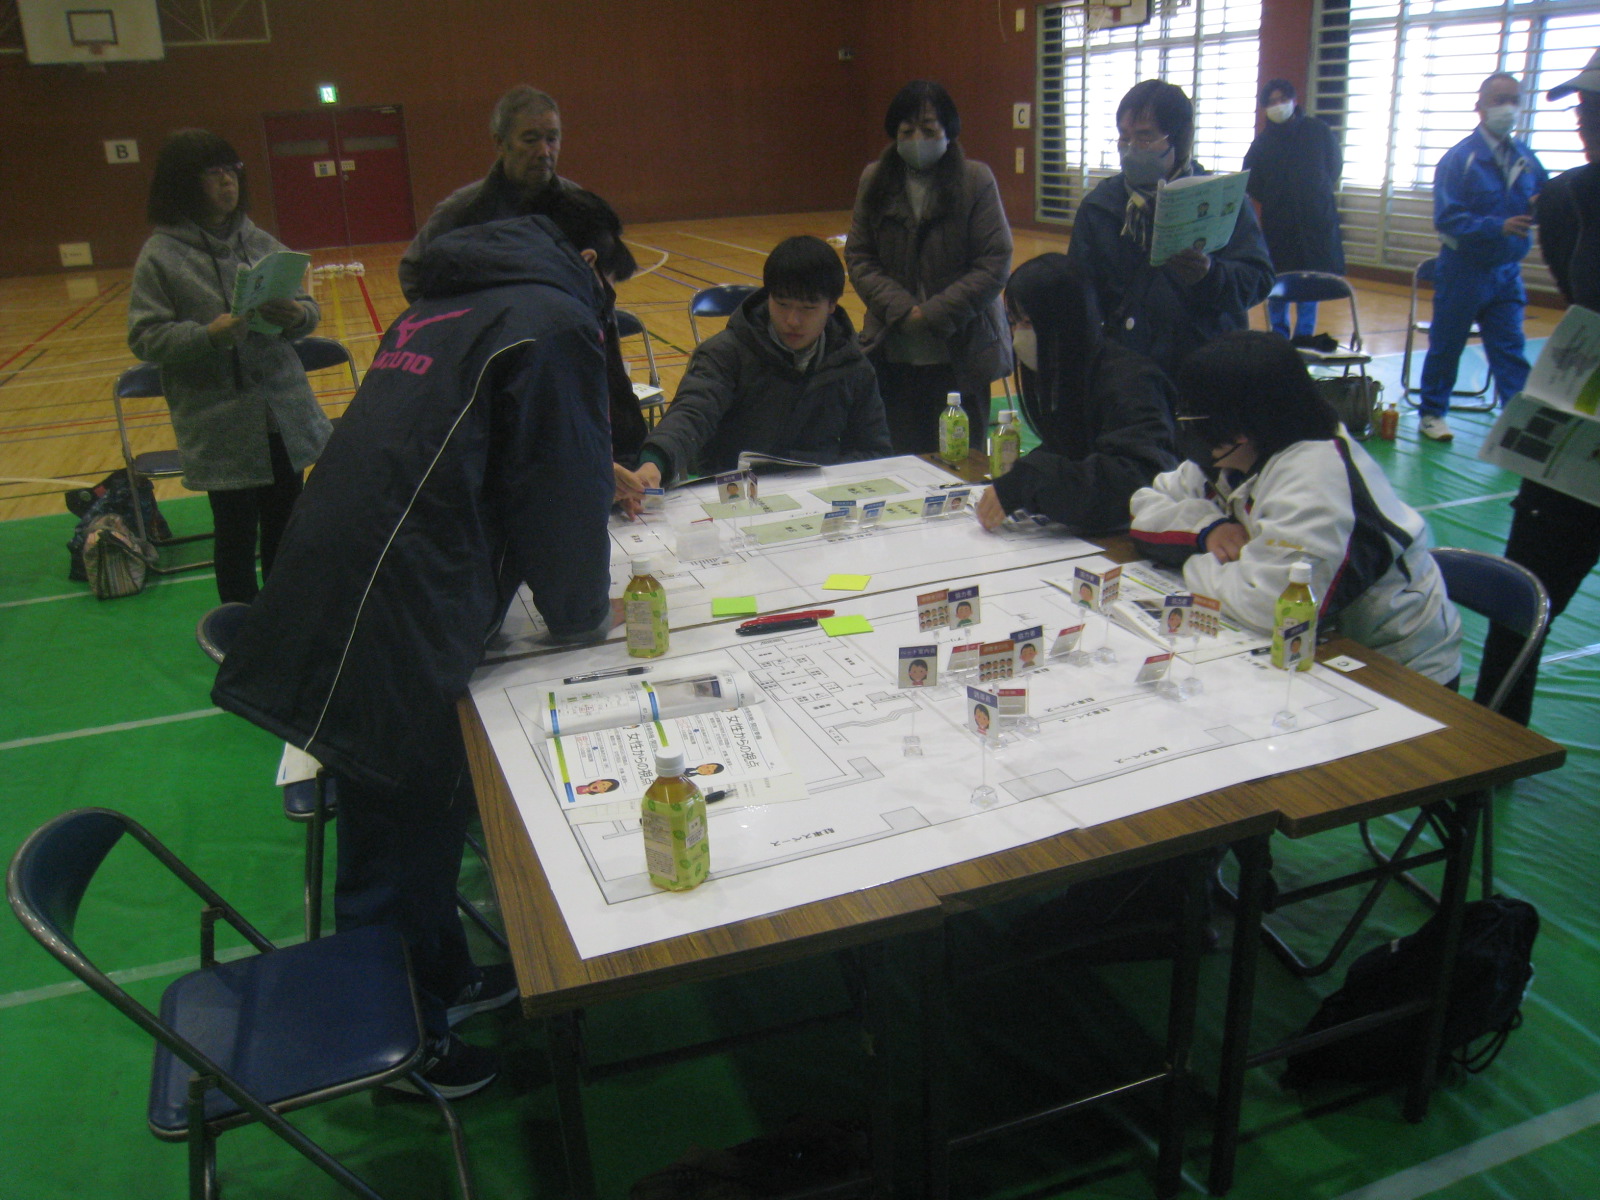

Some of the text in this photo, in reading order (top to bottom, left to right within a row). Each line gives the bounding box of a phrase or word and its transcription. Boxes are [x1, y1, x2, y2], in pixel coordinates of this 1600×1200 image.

[1018, 108, 1025, 124] C
[115, 144, 128, 159] B
[770, 828, 835, 846] 駐車スペース
